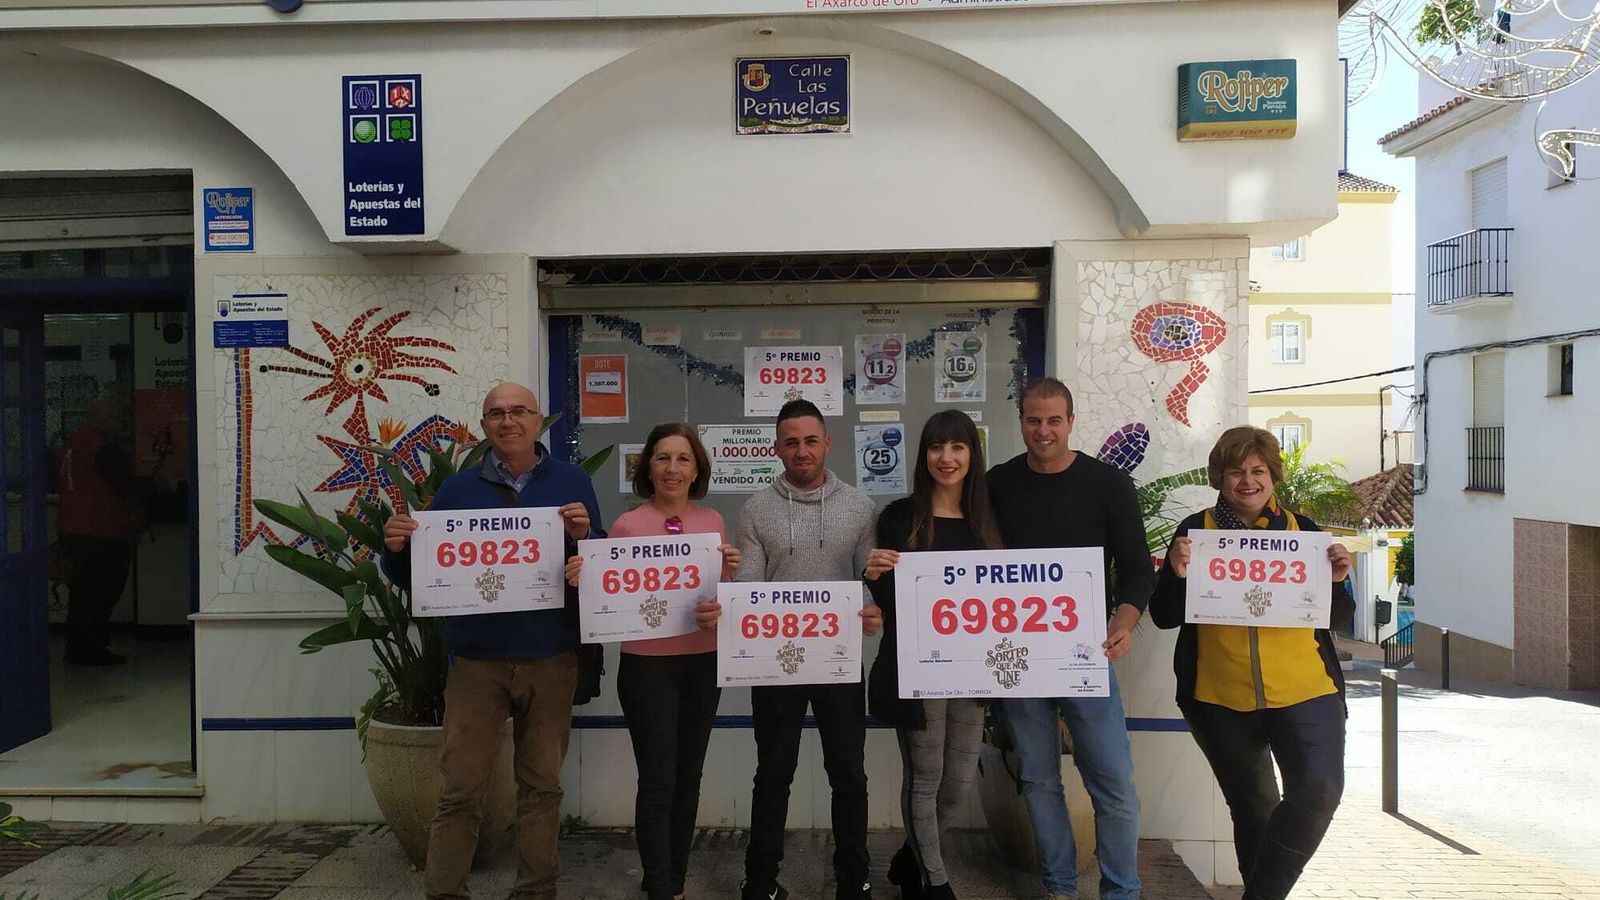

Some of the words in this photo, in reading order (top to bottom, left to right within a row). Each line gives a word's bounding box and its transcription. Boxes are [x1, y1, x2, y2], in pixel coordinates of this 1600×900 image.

[788, 63, 833, 77] Calle
[798, 79, 827, 93] Las
[743, 95, 841, 115] Peñuelas
[348, 181, 394, 193] Loterías
[397, 183, 404, 194] y
[348, 198, 401, 212] Apuestas
[403, 197, 421, 209] del
[349, 215, 388, 227] Estado
[766, 352, 777, 362] 5º
[780, 351, 821, 361] PREMIO
[758, 367, 827, 385] 69823
[722, 437, 771, 445] MILLONARIO
[870, 449, 891, 465] 25
[712, 476, 754, 484] VENDIDO
[446, 517, 462, 533] 5º
[469, 516, 531, 531] PREMIO
[610, 546, 626, 560] 5º
[632, 543, 691, 559] PREMIO
[1218, 538, 1233, 549] 5º
[1240, 538, 1299, 551] PREMIO
[436, 539, 541, 568] 69823
[944, 565, 966, 585] 5º
[975, 563, 1064, 584] PREMIO
[1208, 557, 1307, 584] 69823
[602, 564, 700, 595] 69823
[750, 591, 766, 605] 5º
[772, 590, 831, 604] PREMIO
[931, 595, 1080, 635] 69823
[740, 612, 840, 639] 69823
[995, 637, 1015, 651] EL
[985, 647, 1029, 667] SORTEO
[996, 663, 1011, 673] QUE
[1012, 658, 1029, 671] NOS
[992, 671, 1021, 689] UNE
